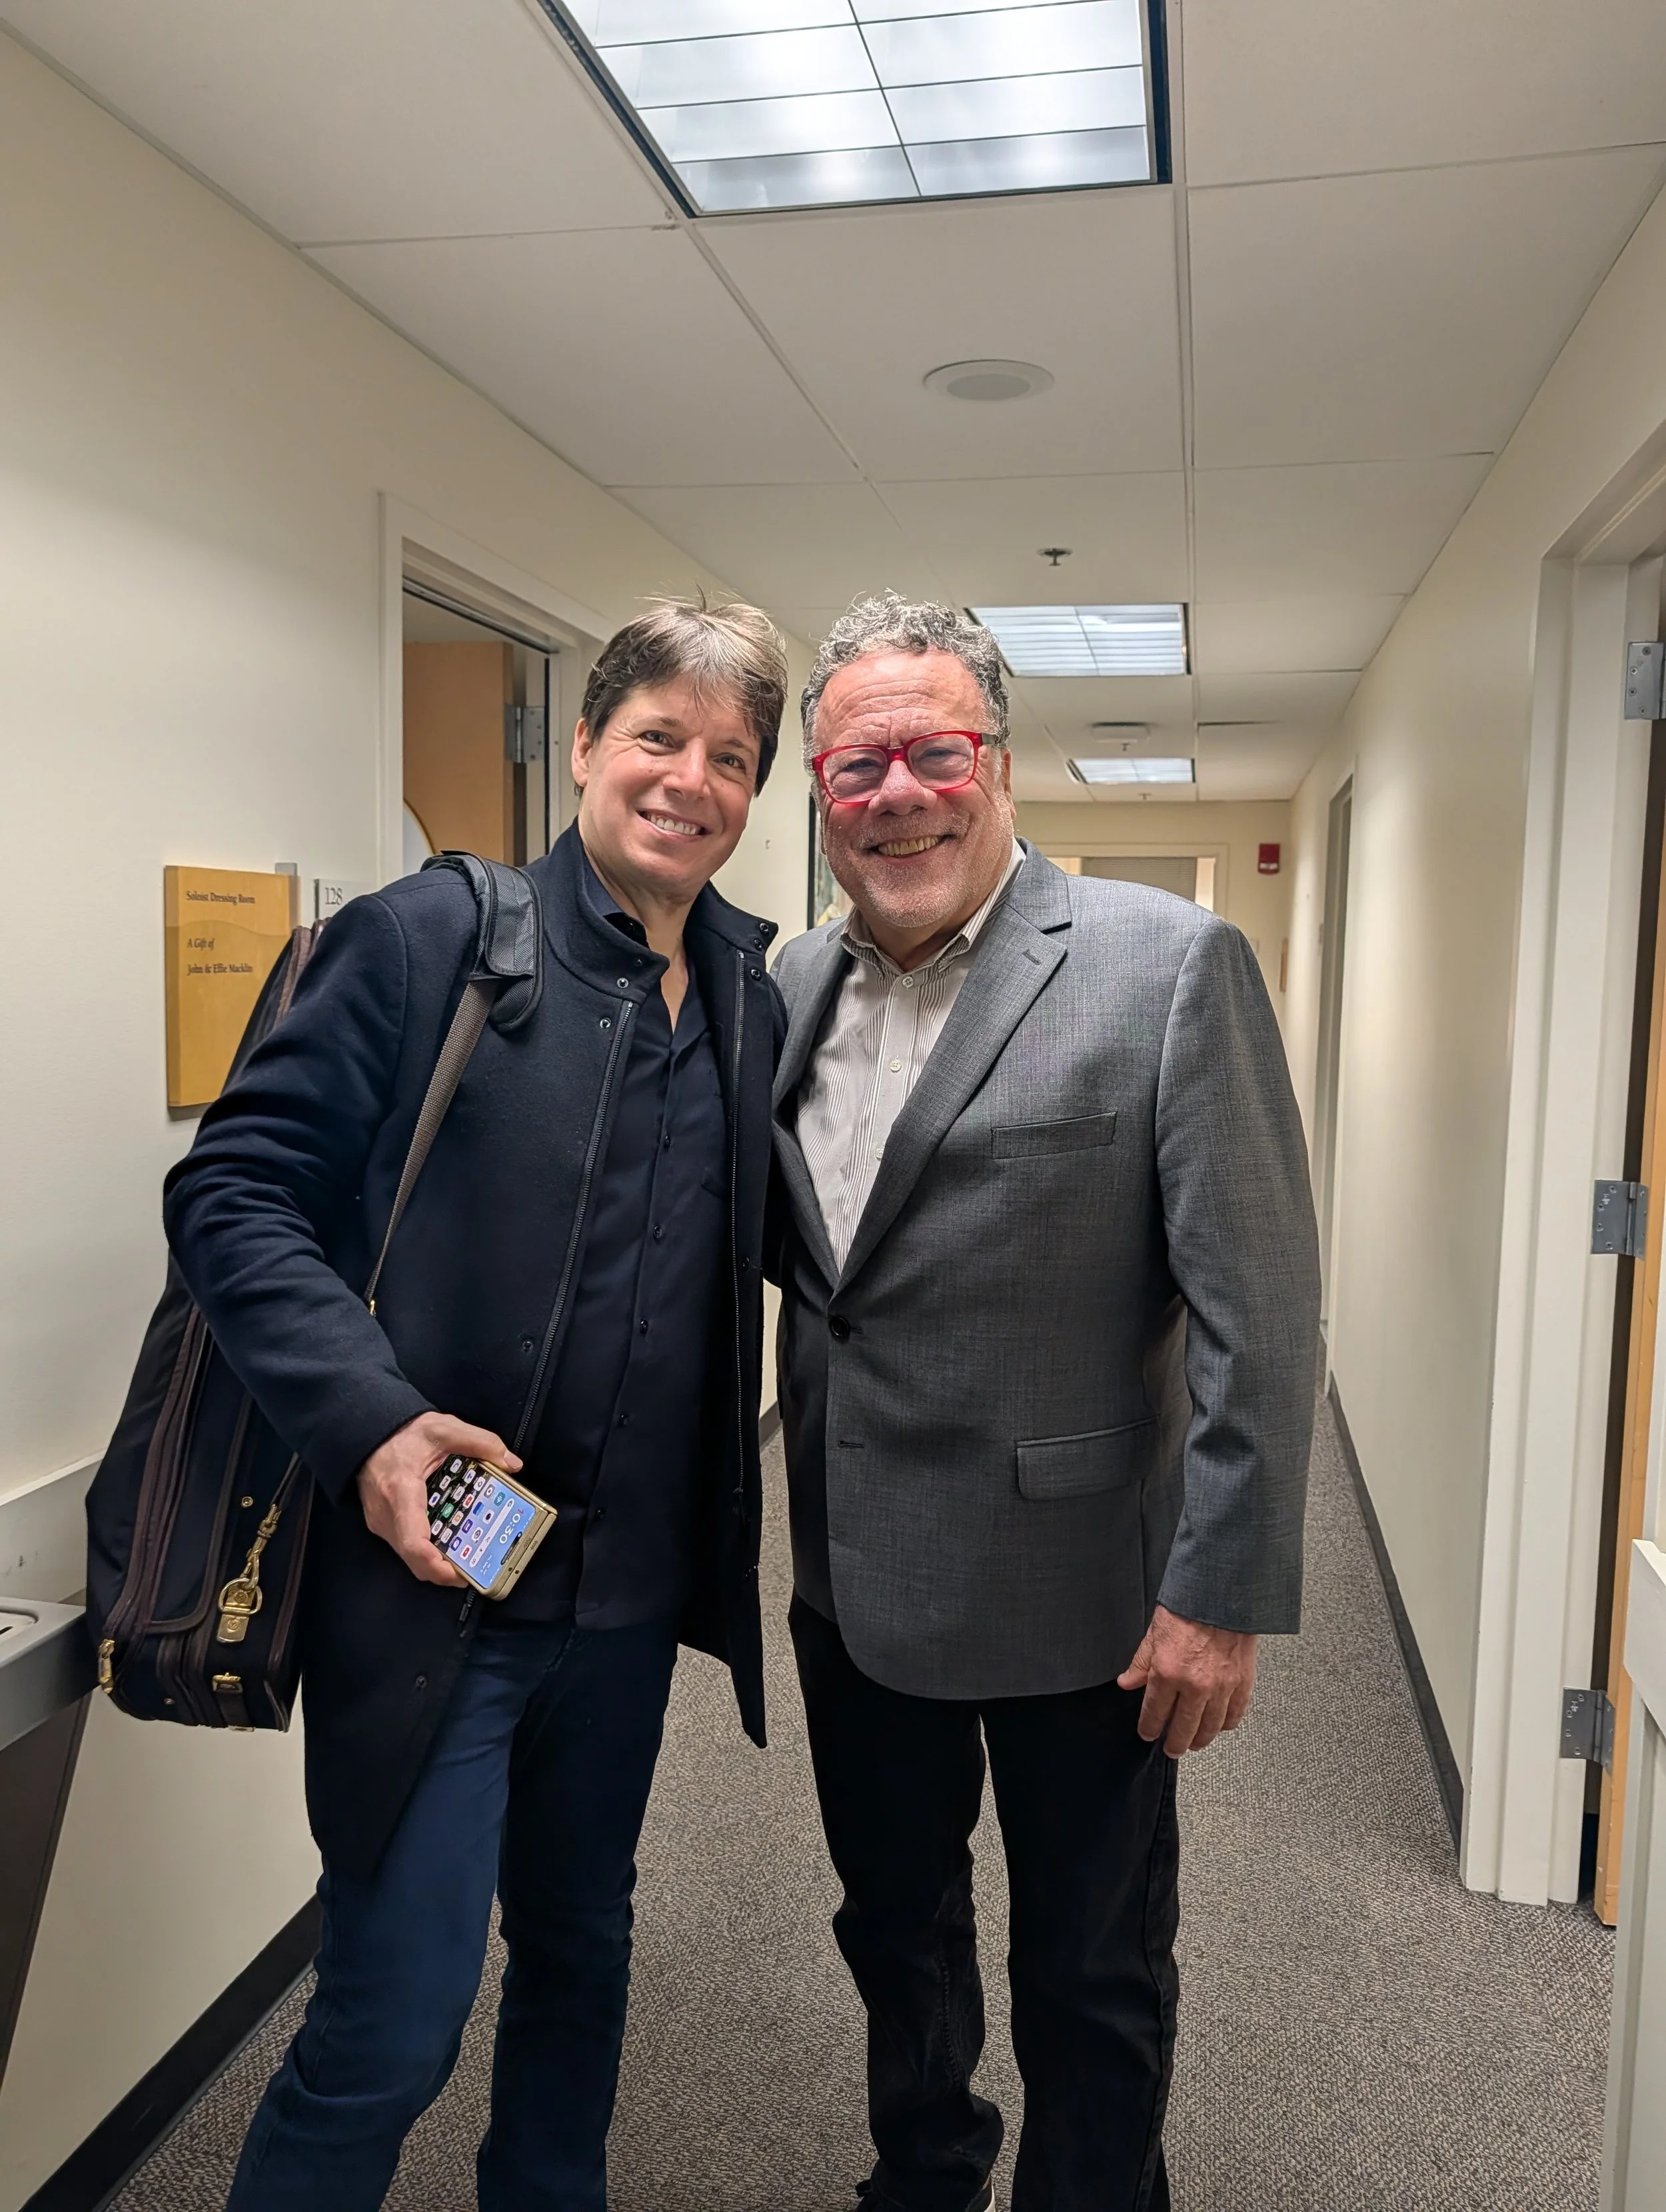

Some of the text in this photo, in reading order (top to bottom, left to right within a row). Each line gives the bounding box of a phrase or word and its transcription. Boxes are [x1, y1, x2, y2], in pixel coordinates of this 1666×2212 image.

[187, 890, 255, 905] Soloist Dressing Room
[325, 887, 343, 905] 128
[187, 938, 215, 951] A Gift of
[187, 963, 203, 976] John
[205, 963, 211, 973] &
[213, 963, 227, 973] Effie
